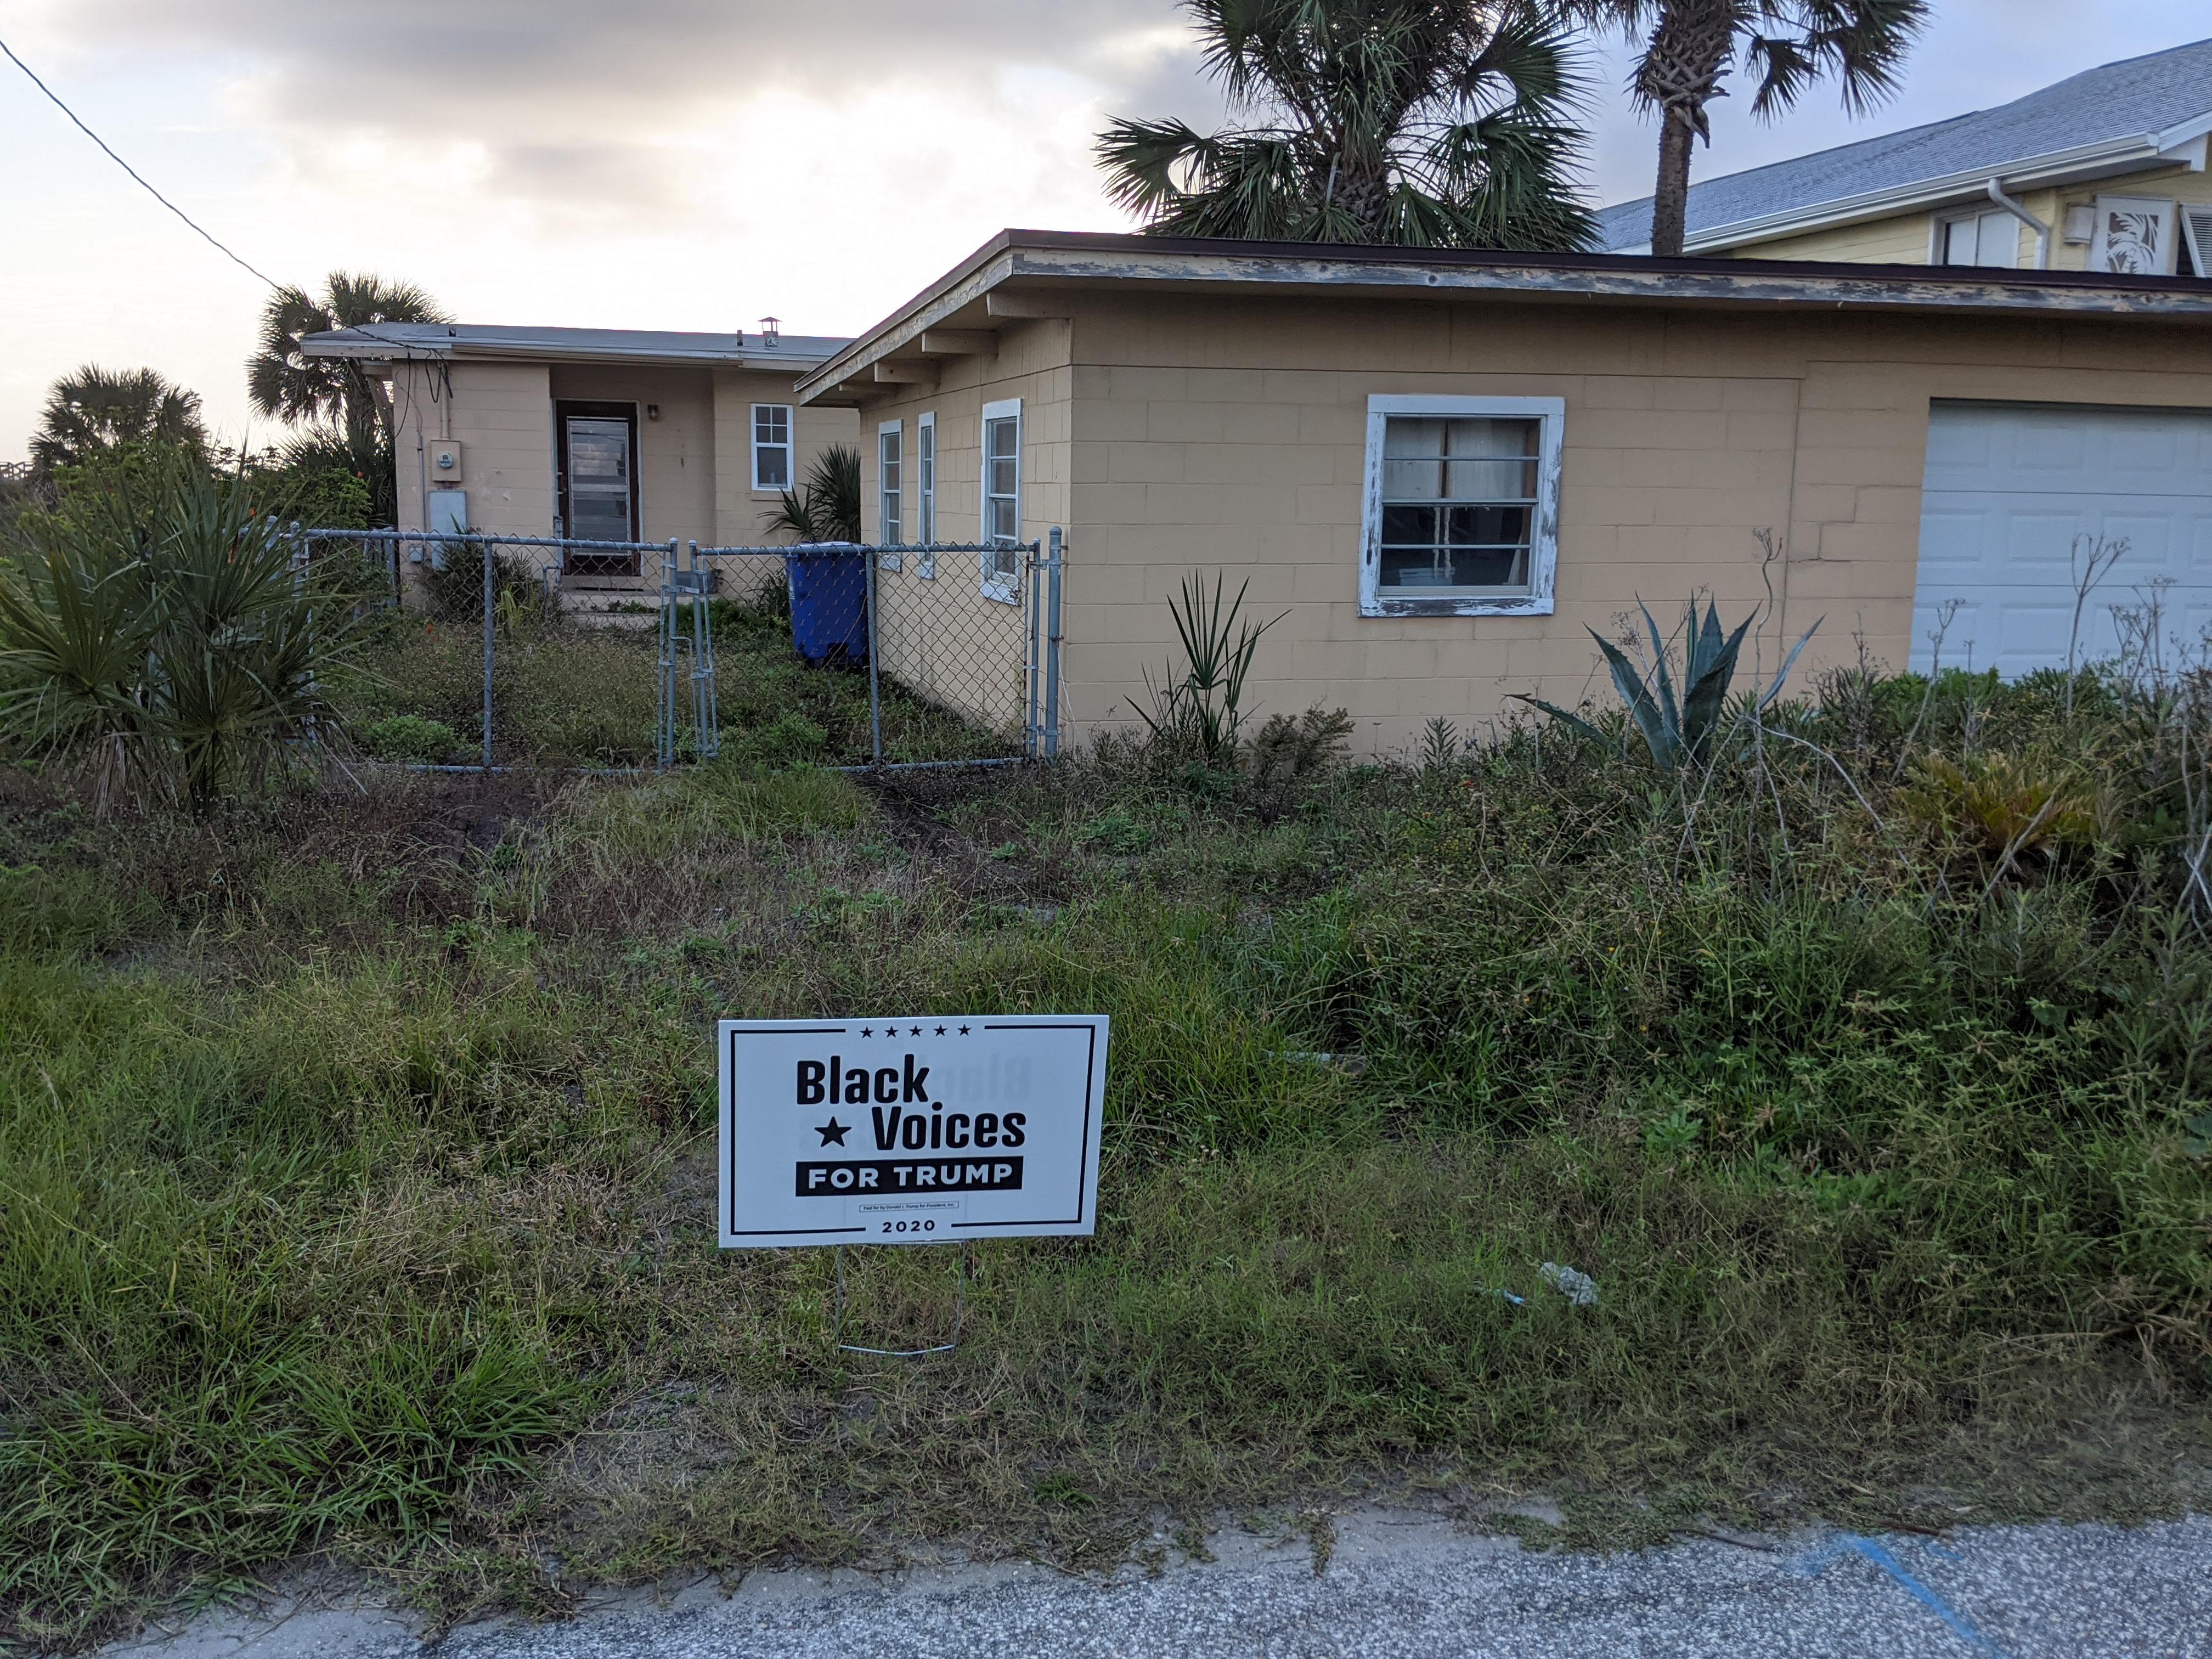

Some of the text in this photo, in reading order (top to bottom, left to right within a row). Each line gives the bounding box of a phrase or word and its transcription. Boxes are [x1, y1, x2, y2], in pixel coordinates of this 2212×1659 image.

[797, 1053, 930, 1105] Black
[871, 1101, 1026, 1151] Voices
[809, 1164, 1012, 1188] FOR TRUMP
[882, 1220, 935, 1233] 2020
